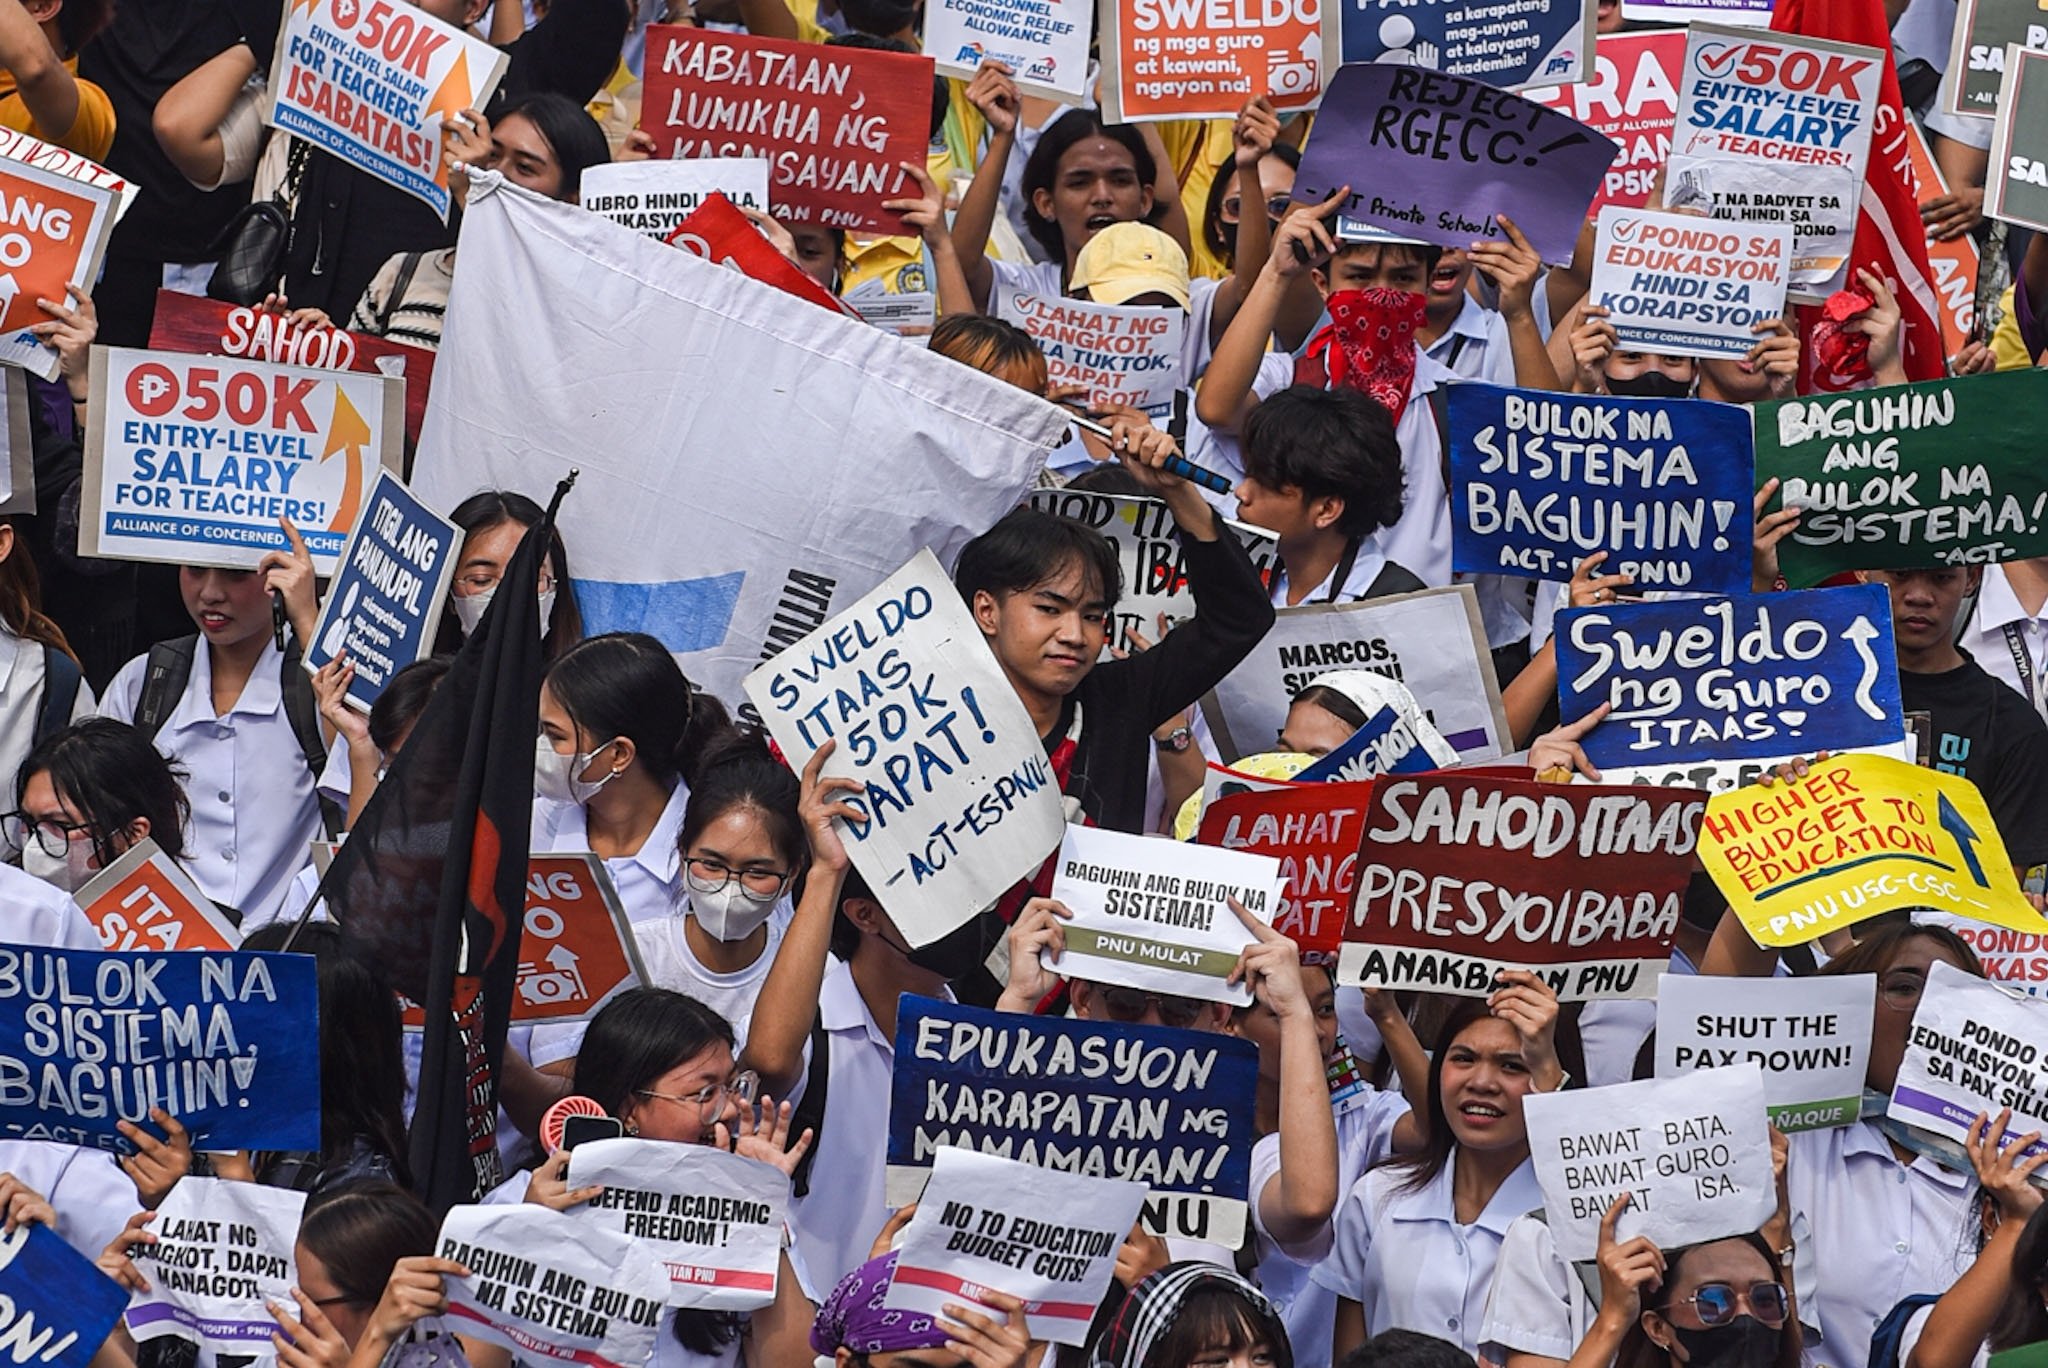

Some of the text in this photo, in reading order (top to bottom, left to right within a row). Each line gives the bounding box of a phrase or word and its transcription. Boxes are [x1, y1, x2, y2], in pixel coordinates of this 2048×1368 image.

[944, 0, 1076, 36] ECONOMIC RELIEF
[964, 17, 1053, 45] ALLOWANCE
[1133, 0, 1321, 31] SWELDO
[1445, 0, 1550, 23] sa karapatang
[1446, 18, 1528, 42] mag-unyon
[309, 25, 429, 103] ENTRY-LEVEL SALARY
[1133, 34, 1265, 55] ng mga guro
[1135, 55, 1242, 77] at kawani,
[1446, 34, 1541, 59] at kalayaang
[1446, 52, 1528, 77] akademiko!
[289, 35, 423, 130] FOR TEACHERS,
[1136, 76, 1251, 99] ngayon na!
[1735, 44, 1873, 101] 50K
[286, 66, 434, 175] ISABATAS!
[666, 87, 890, 153] LUMIKHA NG
[1388, 68, 1558, 132] REJECT
[1692, 80, 1861, 122] ENTRY-LEVEL
[1688, 99, 1857, 150] SALARY
[280, 111, 406, 184] ALLIANCE OF CONCERNED
[1717, 133, 1853, 167] TEACHERS!
[586, 192, 698, 211] LIBRO HINDI
[1605, 168, 1658, 197] P5K
[1726, 193, 1748, 207] NA
[1754, 194, 1815, 209] BADYET
[1820, 196, 1841, 209] SA
[1370, 197, 1499, 237] Private Schools
[1741, 208, 1811, 222] HINDI SA
[1638, 224, 1741, 257] PONDO
[1745, 237, 1782, 258] SA
[1606, 245, 1781, 287] EDUKASYON,
[1631, 272, 1751, 304] HINDI SA
[222, 308, 356, 371] SAHOD
[1025, 317, 1154, 356] SANGKOT,
[1036, 302, 1169, 335] LAHAT NG
[1644, 331, 1722, 348] OF CONCERNED
[1048, 360, 1127, 389] DAPAT
[1073, 349, 1172, 372] TUKTOK,
[1505, 395, 1674, 441] BULOK NA
[1778, 388, 1956, 447] BAGUHIN
[123, 421, 313, 460] ENTRY-LEVEL
[1473, 425, 1699, 488] SISTEMA
[1822, 437, 1900, 473] ANG
[133, 447, 302, 494] SALARY
[1783, 464, 1992, 512] BULOK NA
[115, 484, 326, 523] FOR TEACHERS!
[1467, 481, 1736, 552] BAGUHIN!
[1792, 491, 2048, 545] SISTEMA!
[112, 518, 285, 547] ALLIANCE OF CONCERNED
[397, 523, 439, 572] ANG
[353, 535, 424, 617] PANUNUPIL
[1619, 560, 1693, 586] PNU
[769, 586, 932, 711] SWELDO
[1278, 639, 1398, 669] MARCOS,
[1571, 601, 1829, 693] Sweldo
[796, 649, 912, 749] ITAAS
[1610, 669, 1832, 718] ng Guro
[848, 673, 946, 766] 50K
[841, 686, 996, 841] DAPAT!
[1222, 808, 1357, 848] LAHAT
[1368, 781, 1705, 859] SAHOD ITAAS
[1705, 768, 1861, 845] HIGHER
[1725, 797, 1927, 873] BUDGET TO
[1280, 852, 1358, 896] ANG
[1736, 824, 1938, 893] EDUCATION
[1065, 860, 1268, 913] BAGUHIN ANG BULOK NA
[1353, 863, 1553, 944] PRESYO
[1104, 888, 1216, 932] SISTEMA!
[1096, 935, 1205, 966] PNU MULAT
[0, 949, 277, 1006] BULOK NA
[1576, 962, 1640, 995] PNU
[1696, 1014, 1839, 1040] SHUT THE
[1961, 1019, 2037, 1065] PONDO
[915, 1015, 1218, 1092] EDUKASYON
[1675, 1044, 1853, 1072] PAX DOWN!
[1912, 1025, 2037, 1096] EDUKASYON,
[1926, 1055, 1998, 1102] SA PAX
[926, 1079, 1230, 1141] KARAPATAN NG
[1560, 1115, 1735, 1161] BAWAT BATA.
[1565, 1144, 1737, 1191] BAWAT GURO.
[1694, 1172, 1740, 1201] ISA.
[588, 1186, 771, 1225] DEFEND ACADEMIC
[160, 1216, 257, 1248] LAHAT NG
[624, 1212, 714, 1248] FREEDOM
[940, 1200, 1117, 1258] NO TO EDUCATION
[228, 1249, 288, 1280] DAPAT
[946, 1231, 1093, 1283] BUDGET CUTS!
[156, 1265, 261, 1300] MANAGOT!
[441, 1237, 662, 1329] BAGUHIN ANG BULOK
[474, 1279, 609, 1341] NA SISTEMA
